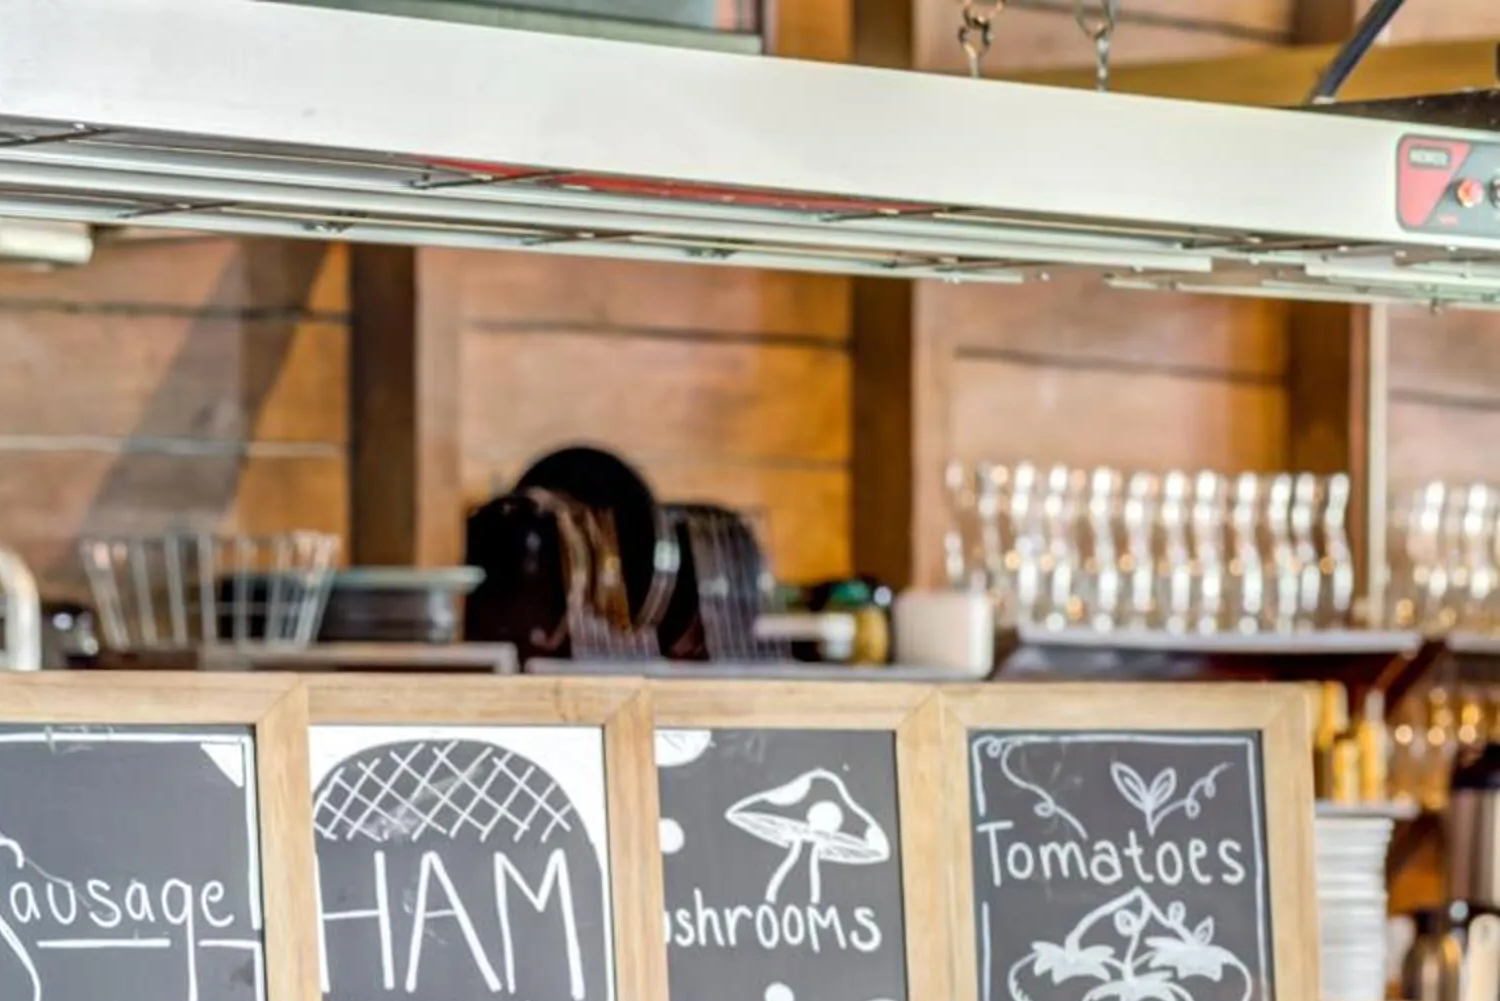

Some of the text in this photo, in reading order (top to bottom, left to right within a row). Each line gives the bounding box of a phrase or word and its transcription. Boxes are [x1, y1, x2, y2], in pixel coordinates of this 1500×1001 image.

[977, 821, 1245, 886] Tomatoes
[314, 848, 585, 1001] HAM
[664, 887, 882, 953] shrooms
